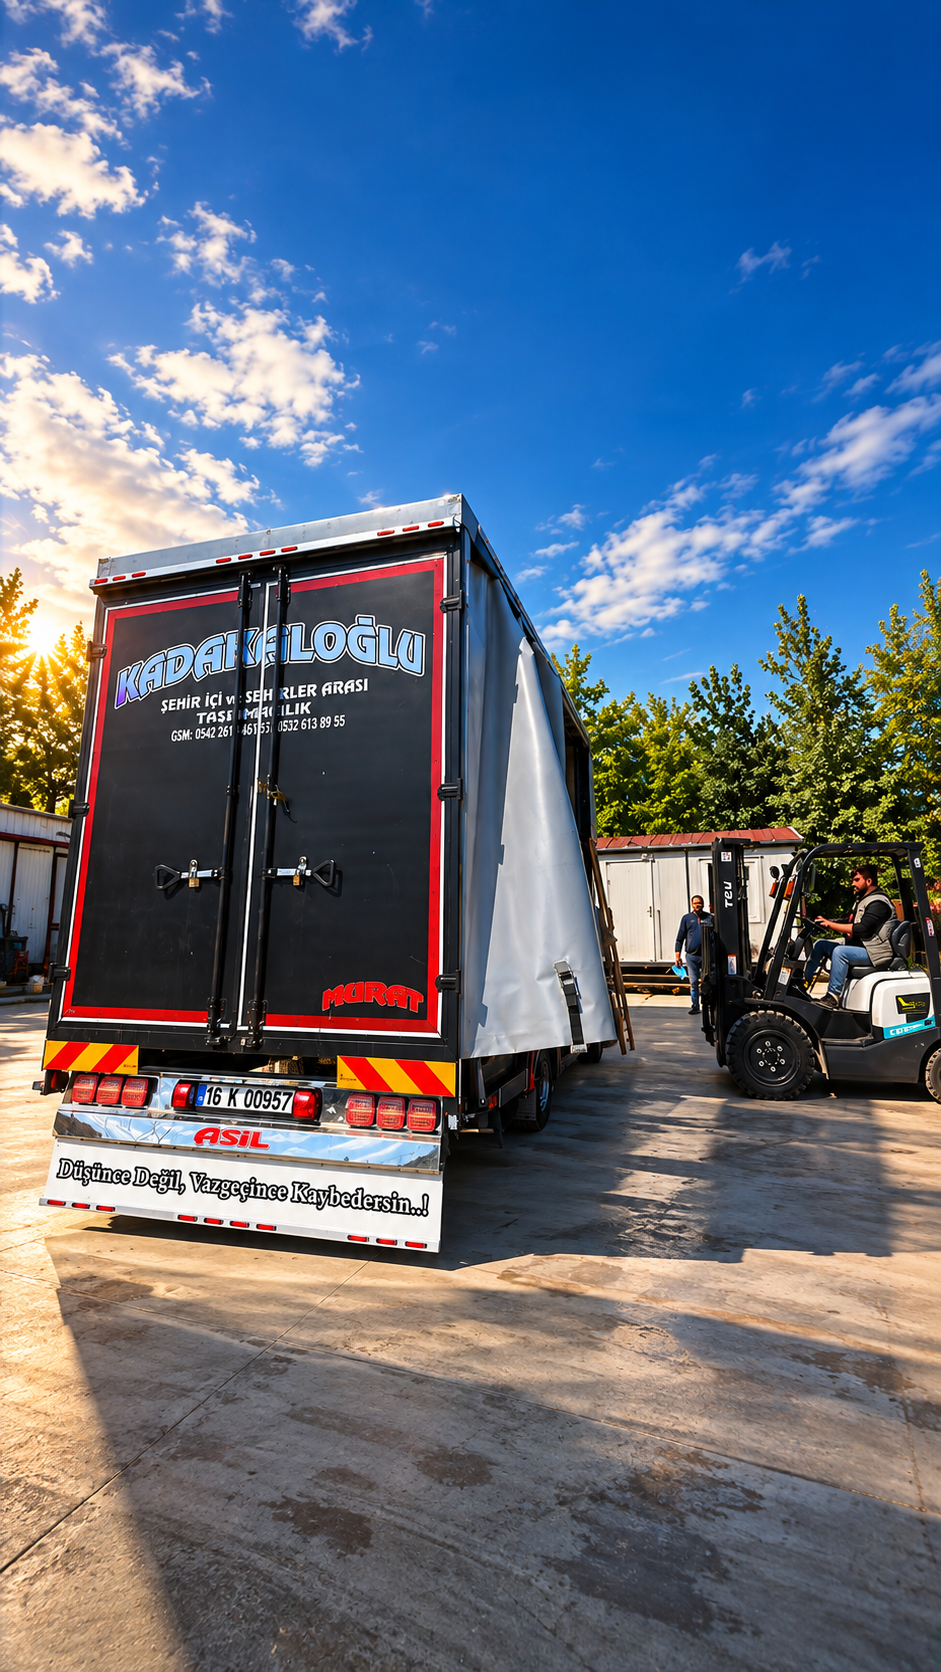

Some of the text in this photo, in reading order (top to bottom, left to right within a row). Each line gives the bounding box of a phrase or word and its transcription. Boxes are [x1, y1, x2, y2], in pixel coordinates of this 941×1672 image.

[114, 614, 426, 710] KADAKALOĞLU
[160, 694, 202, 715] ŞEHİR
[204, 691, 223, 710] İÇİ
[321, 678, 368, 697] ARASI
[171, 729, 193, 742] GSM:
[195, 726, 216, 740] 0542
[217, 724, 233, 739] 261
[277, 719, 300, 733] 0532
[300, 717, 318, 731] 613
[319, 715, 333, 730] 89
[333, 714, 346, 729] 55
[321, 981, 424, 1013] MURAT
[206, 1086, 294, 1112] 16 K 00957
[56, 1157, 430, 1217] Düşünce Değil, Vazgeçince Kaybedersin..!
